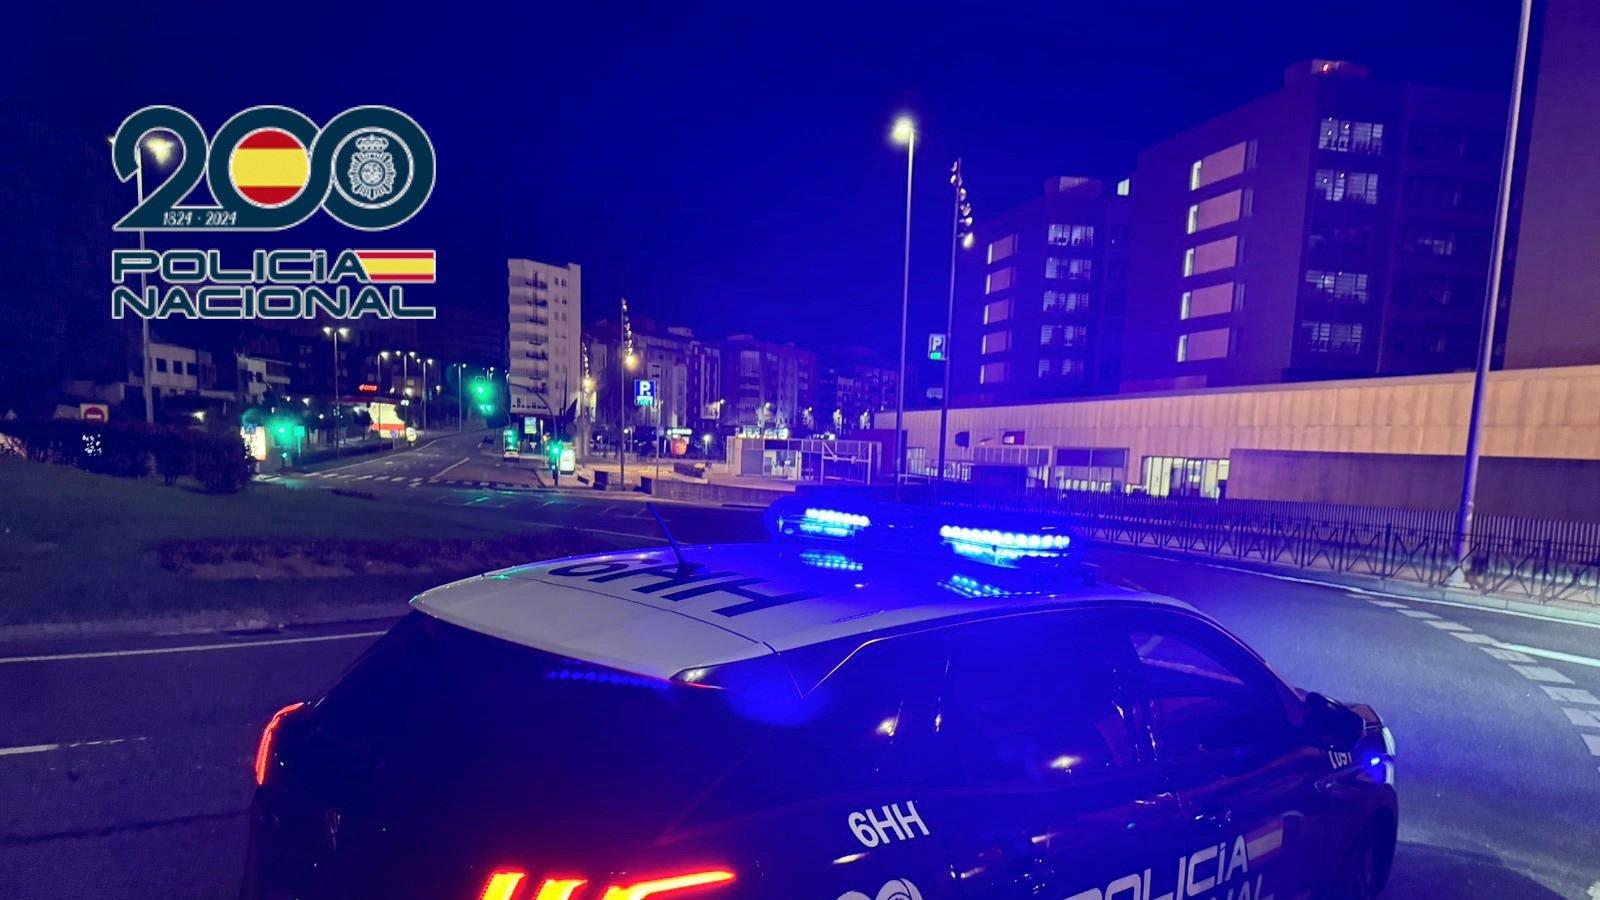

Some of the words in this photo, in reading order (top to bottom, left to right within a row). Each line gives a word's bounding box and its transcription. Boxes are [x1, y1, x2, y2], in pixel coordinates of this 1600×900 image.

[930, 336, 942, 352] P
[639, 381, 651, 396] P
[848, 800, 930, 847] 6HH
